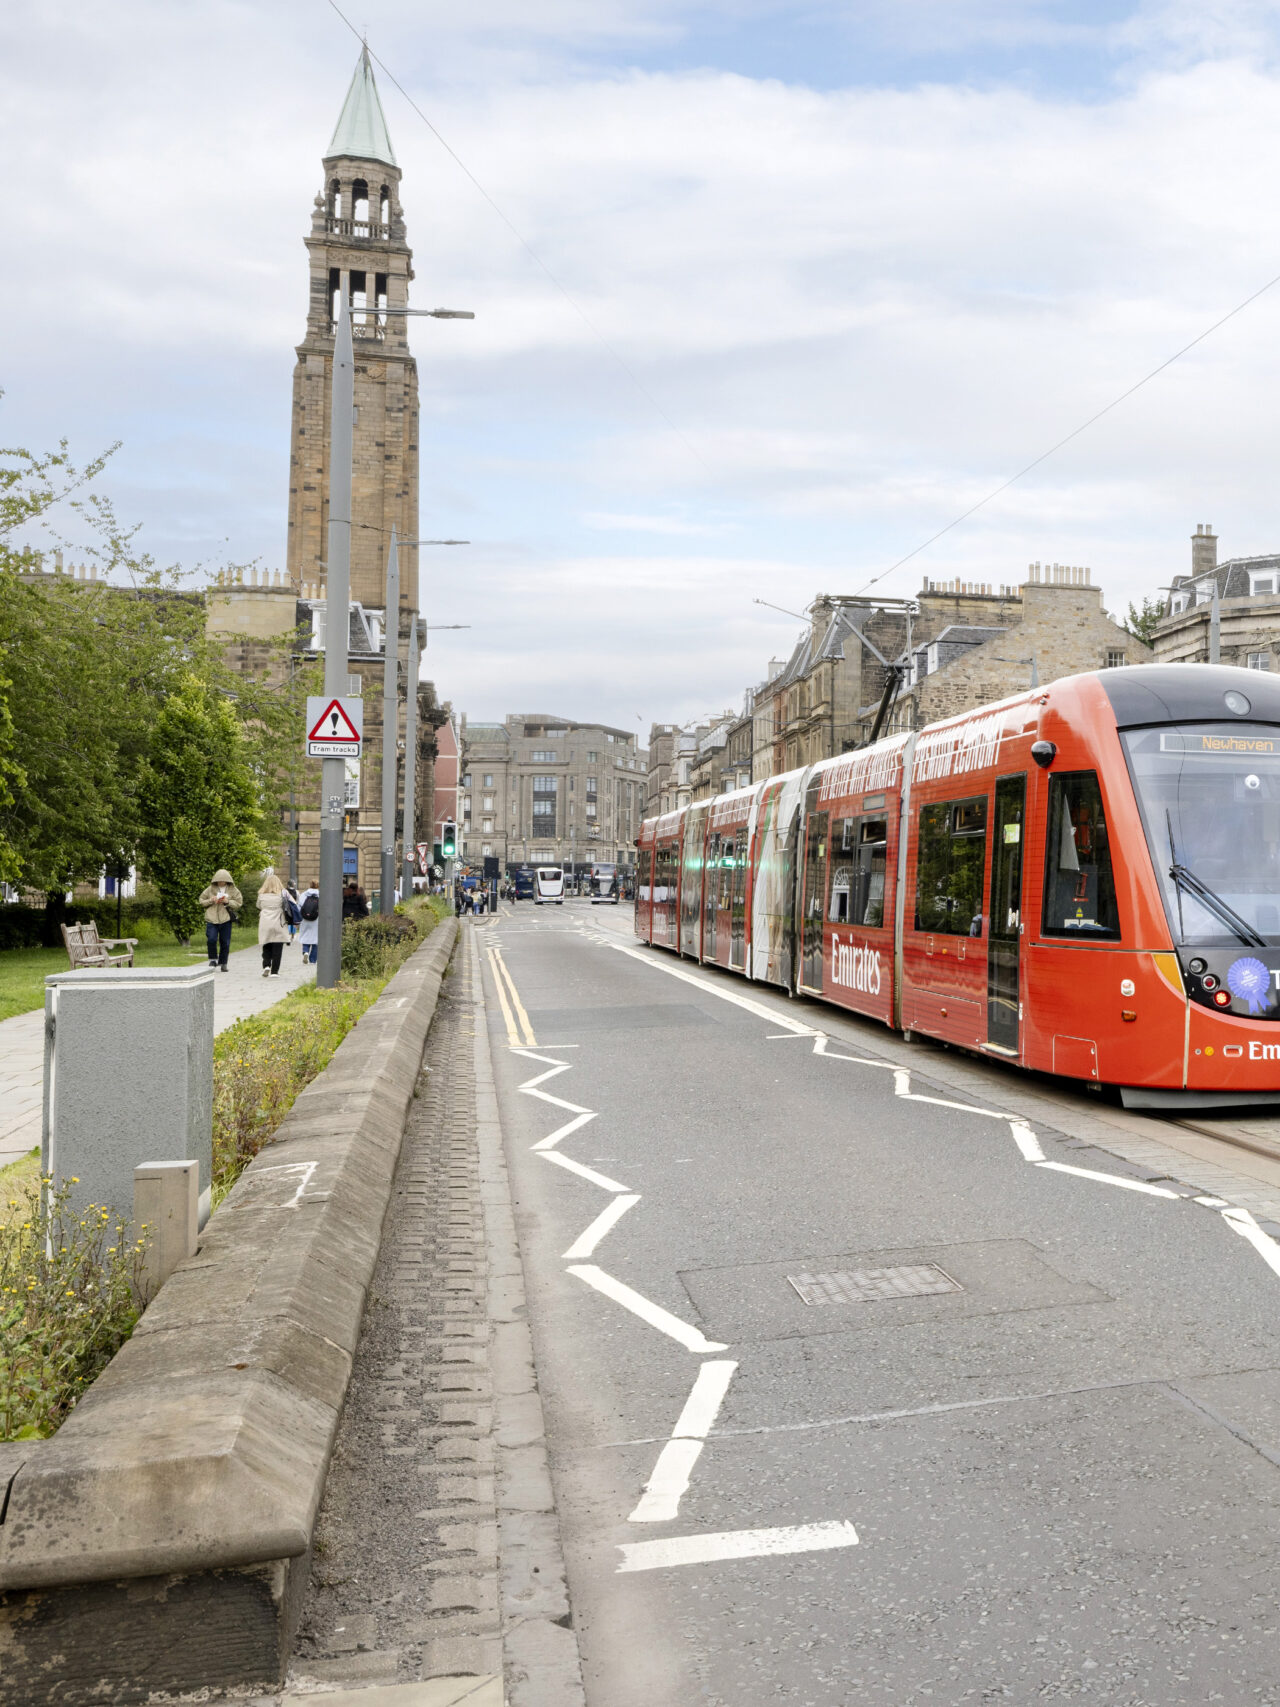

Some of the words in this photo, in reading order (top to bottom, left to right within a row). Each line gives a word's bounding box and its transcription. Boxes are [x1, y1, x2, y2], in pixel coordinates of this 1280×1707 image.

[312, 745, 331, 753] Tram
[332, 746, 356, 754] tracks
[1202, 735, 1274, 752] Newhaven
[831, 932, 881, 996] Emirates
